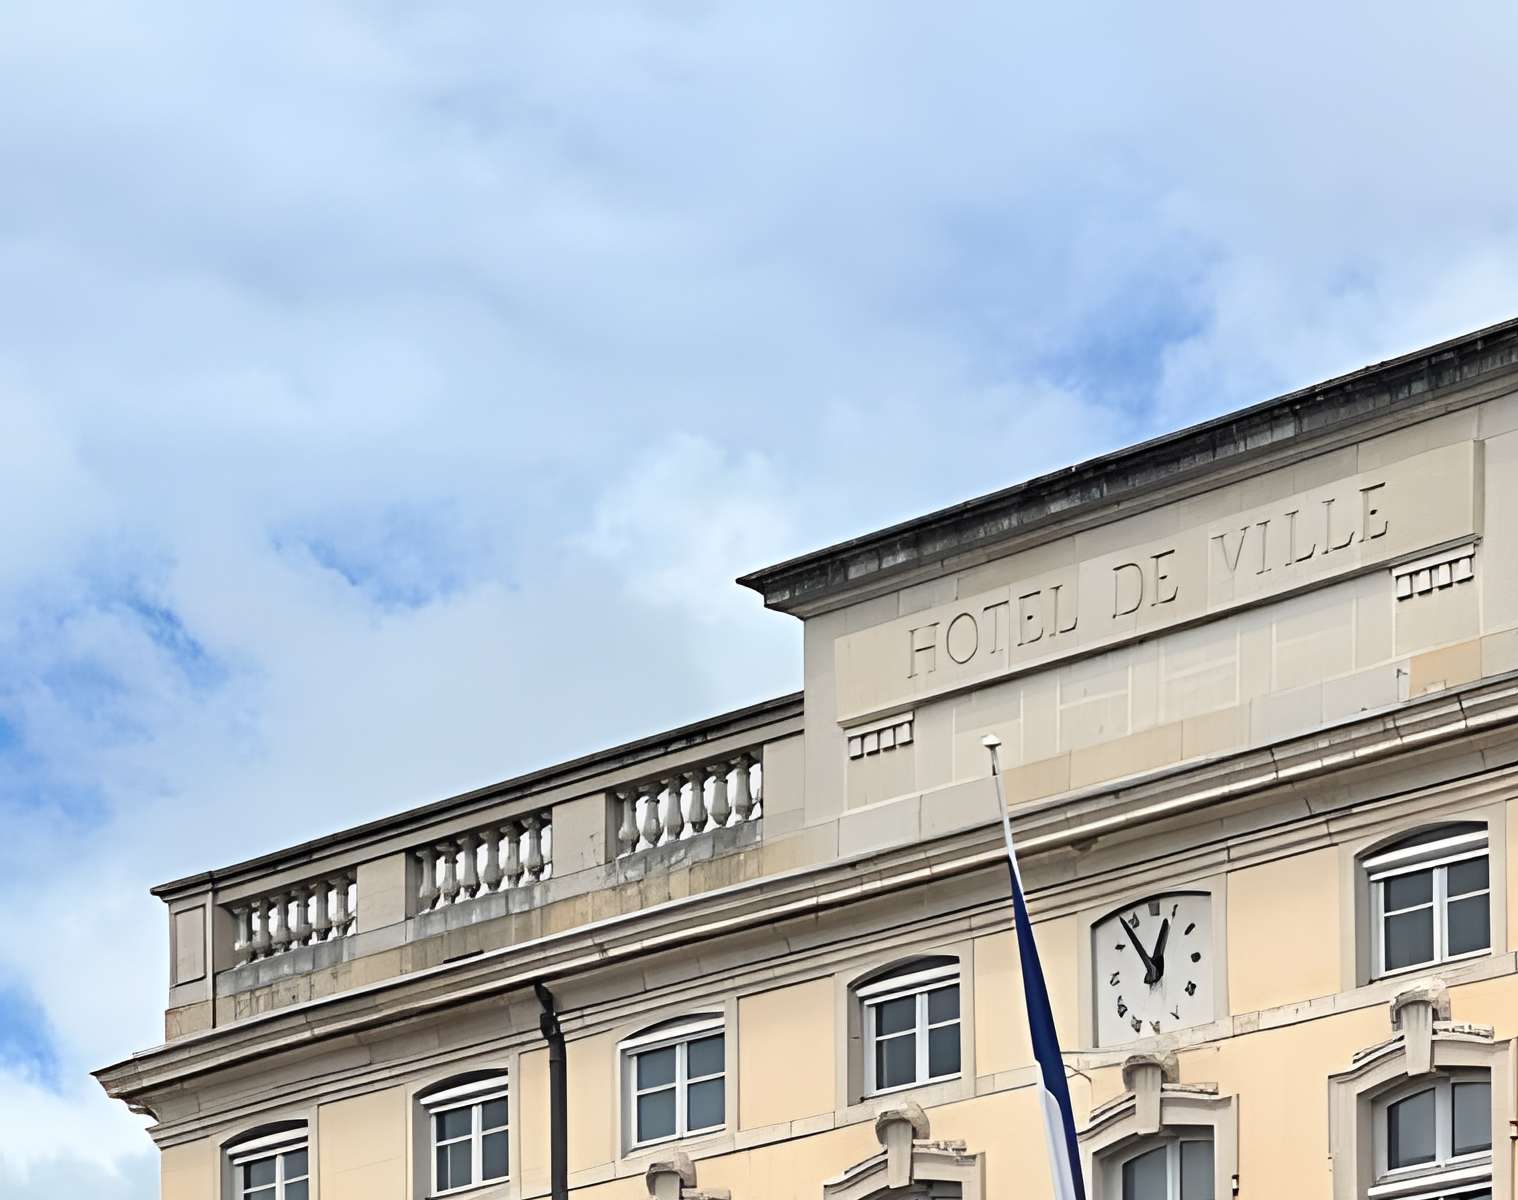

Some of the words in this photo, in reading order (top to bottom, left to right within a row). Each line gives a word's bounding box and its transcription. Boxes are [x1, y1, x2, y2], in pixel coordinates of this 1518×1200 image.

[908, 584, 1079, 679] HOTEL
[1112, 549, 1179, 619] DE
[1211, 482, 1389, 575] VILLE
